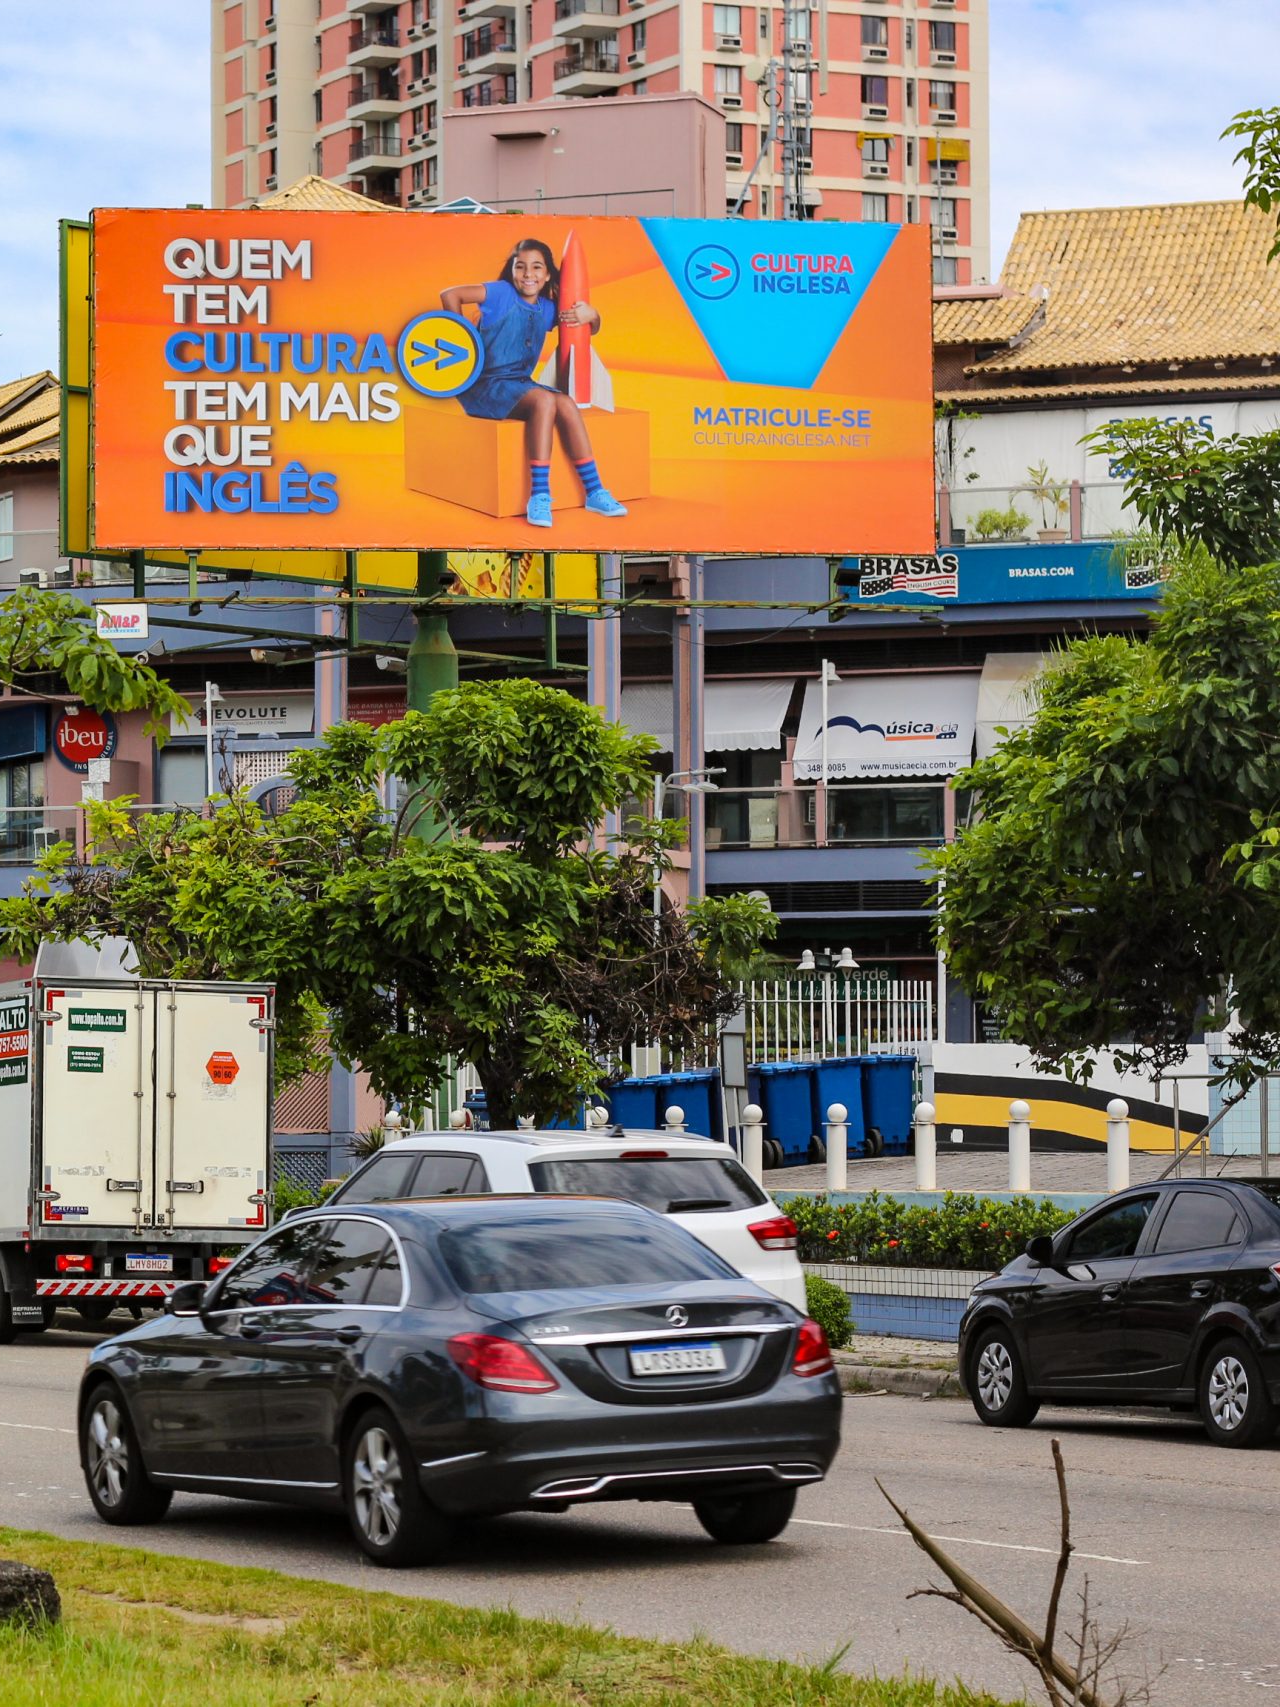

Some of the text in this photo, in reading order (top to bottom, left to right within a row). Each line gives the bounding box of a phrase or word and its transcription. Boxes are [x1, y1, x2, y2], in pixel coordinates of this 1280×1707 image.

[163, 238, 311, 280] QUEM
[751, 254, 854, 274] CULTURA
[753, 275, 851, 294] INGLESA
[163, 285, 267, 324] TEM
[164, 331, 395, 374] CULTURA
[163, 381, 401, 422] TEM MAIS
[693, 407, 871, 428] MATRICULE-SE
[163, 425, 272, 466] QUE
[693, 432, 871, 447] CULTURAINGLESA.NET
[164, 461, 340, 513] INGLÊS
[861, 555, 957, 575] BRASAS
[1008, 566, 1074, 578] BRASAS.COM
[101, 615, 140, 628] AM&P
[215, 707, 287, 719] EVOLUTE
[59, 721, 104, 747] ibeu
[861, 762, 958, 771] www.musicaecia.com.br
[842, 967, 889, 981] Verde
[0, 1007, 26, 1031] ALTO
[71, 1012, 124, 1028] www.topalto.com.br
